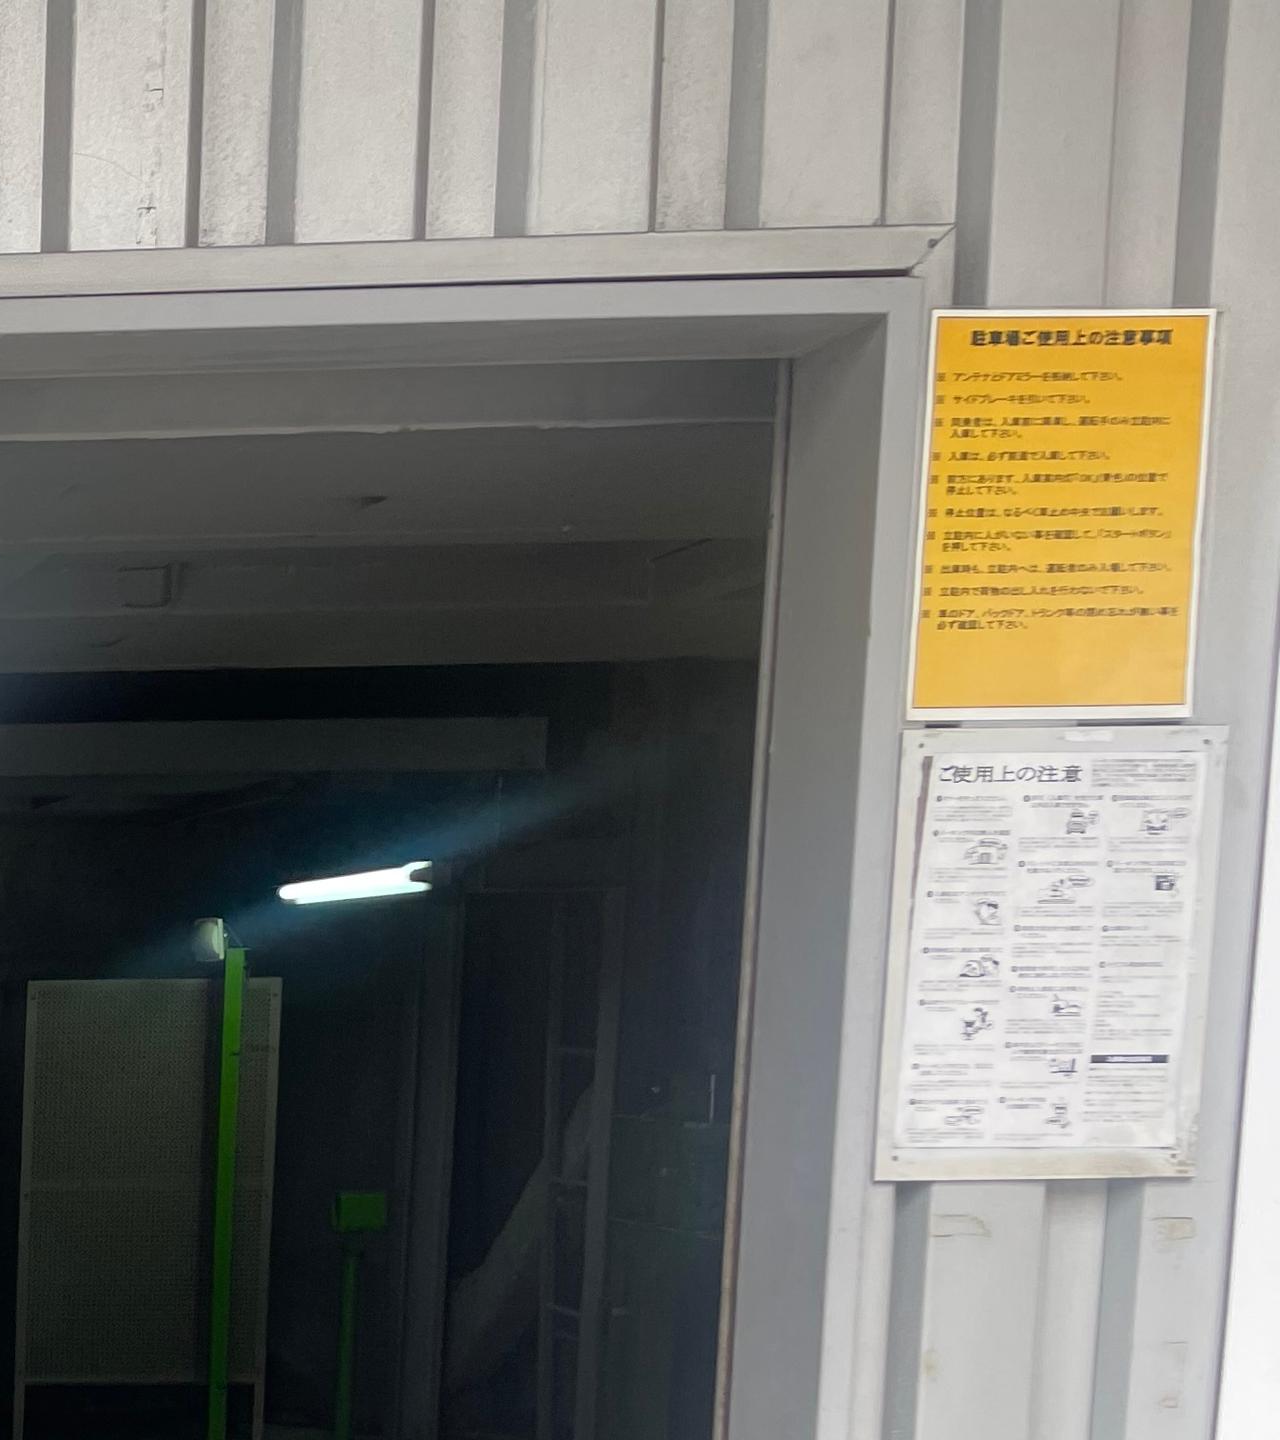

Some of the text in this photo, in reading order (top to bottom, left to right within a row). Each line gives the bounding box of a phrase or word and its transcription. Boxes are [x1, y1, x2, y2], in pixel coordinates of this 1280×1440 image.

[940, 765, 1083, 784] ご使用上の注意
